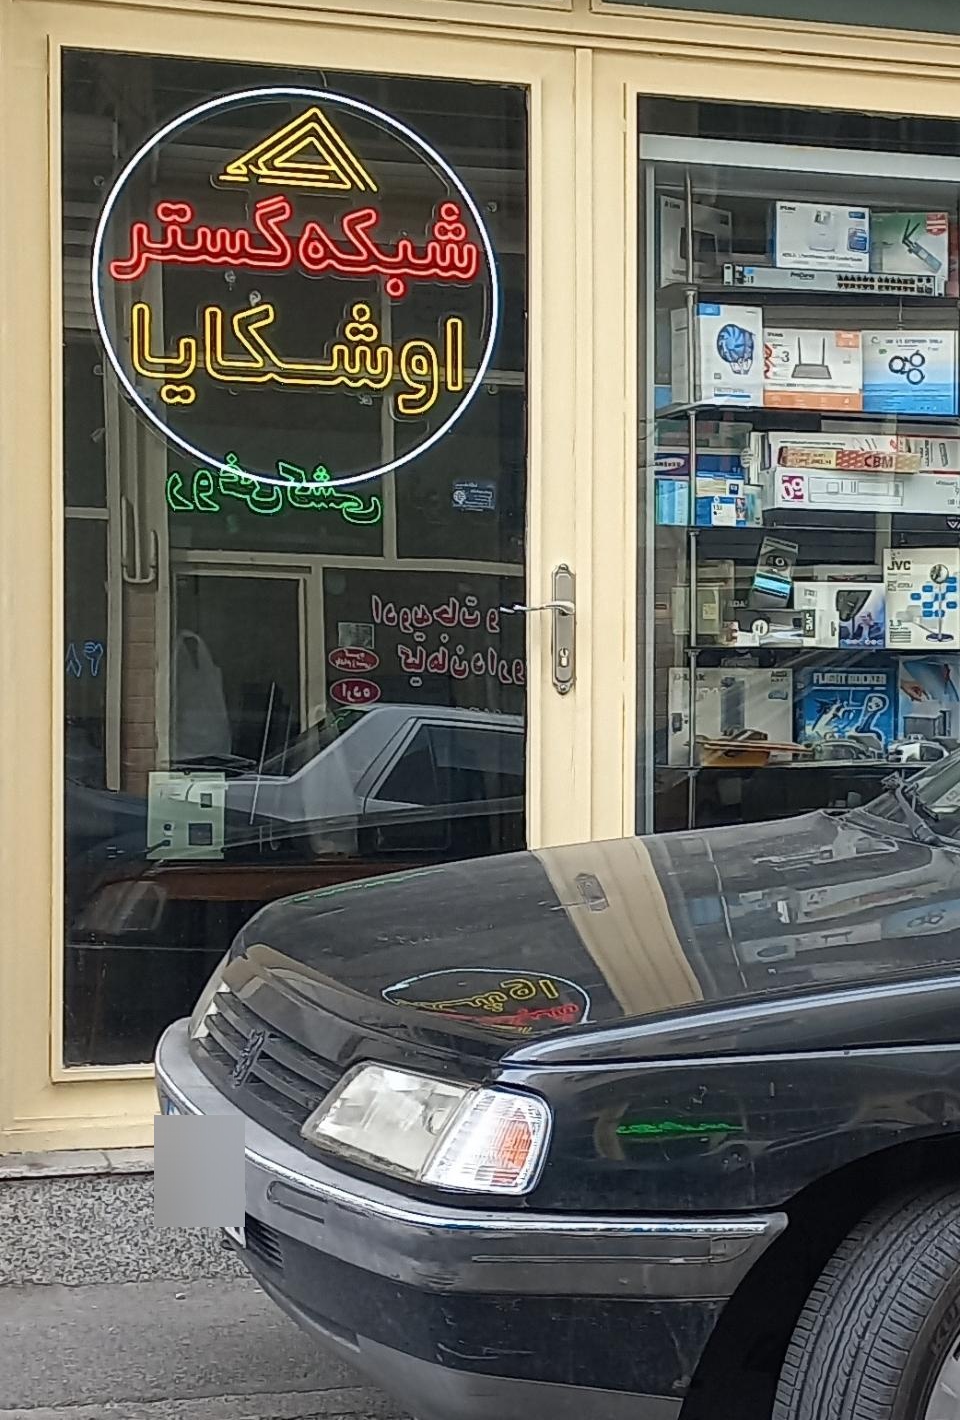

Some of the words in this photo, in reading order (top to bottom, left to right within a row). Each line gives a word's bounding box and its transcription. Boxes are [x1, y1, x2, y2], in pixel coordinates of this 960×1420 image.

[108, 195, 292, 280] گستر
[299, 202, 478, 297] شبکه
[132, 302, 464, 414] اوشکایا
[887, 560, 911, 571] JVC
[805, 612, 813, 631] JVC
